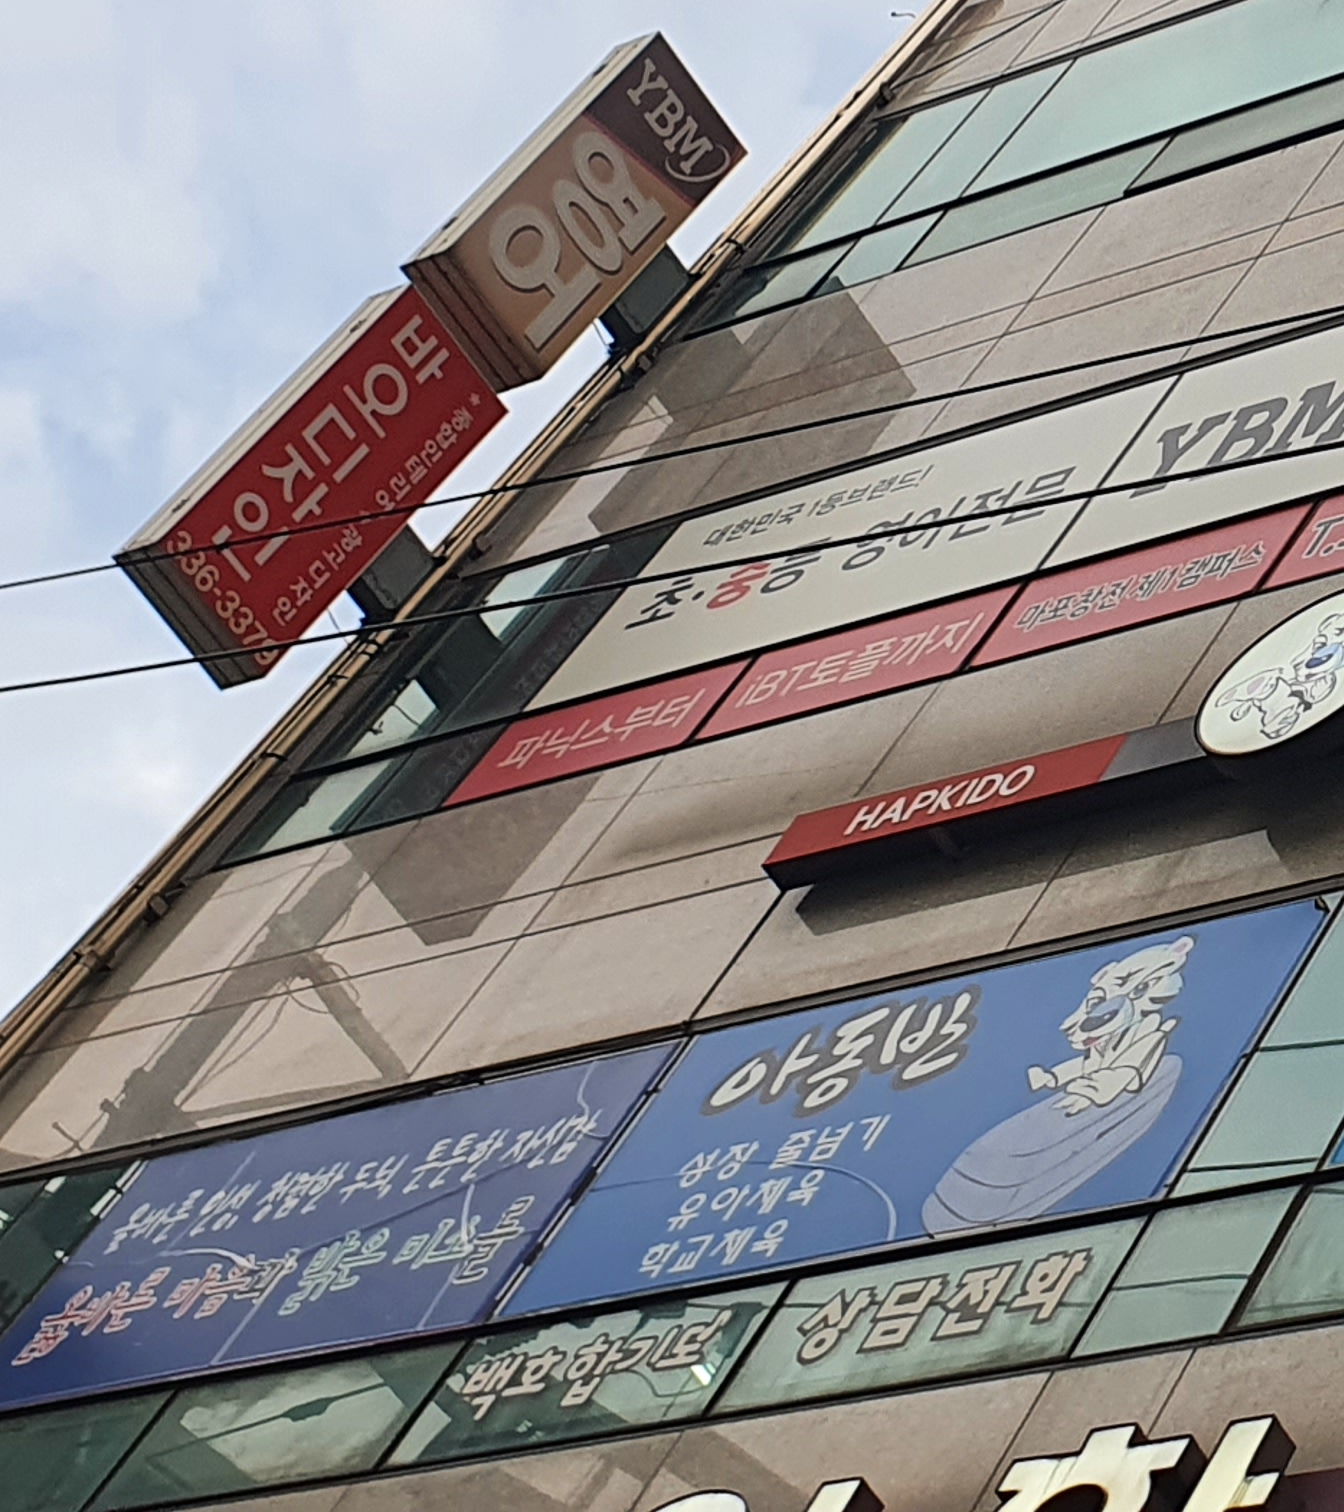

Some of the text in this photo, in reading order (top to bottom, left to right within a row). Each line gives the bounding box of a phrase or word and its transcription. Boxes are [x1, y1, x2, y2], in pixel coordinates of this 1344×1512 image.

[626, 58, 722, 178] YBM
[488, 131, 668, 351] 영어
[212, 315, 451, 584] 바오디자인
[375, 406, 474, 509] 종합인테리어
[271, 521, 363, 629] 광고디자인
[703, 506, 802, 547] 대한민국
[497, 688, 706, 770] 파닉스부터
[734, 612, 984, 710] iBT토플까지
[842, 765, 1036, 837] HAPKIDO
[706, 988, 974, 1112] 아동반
[402, 1129, 505, 1195] 튼튼한
[667, 1169, 826, 1233] 유아체육
[676, 1113, 890, 1188] 성장 줄넘기
[277, 1227, 397, 1317] 밝은
[640, 1219, 791, 1277] 학교체육
[799, 1247, 1094, 1364] 상담전화
